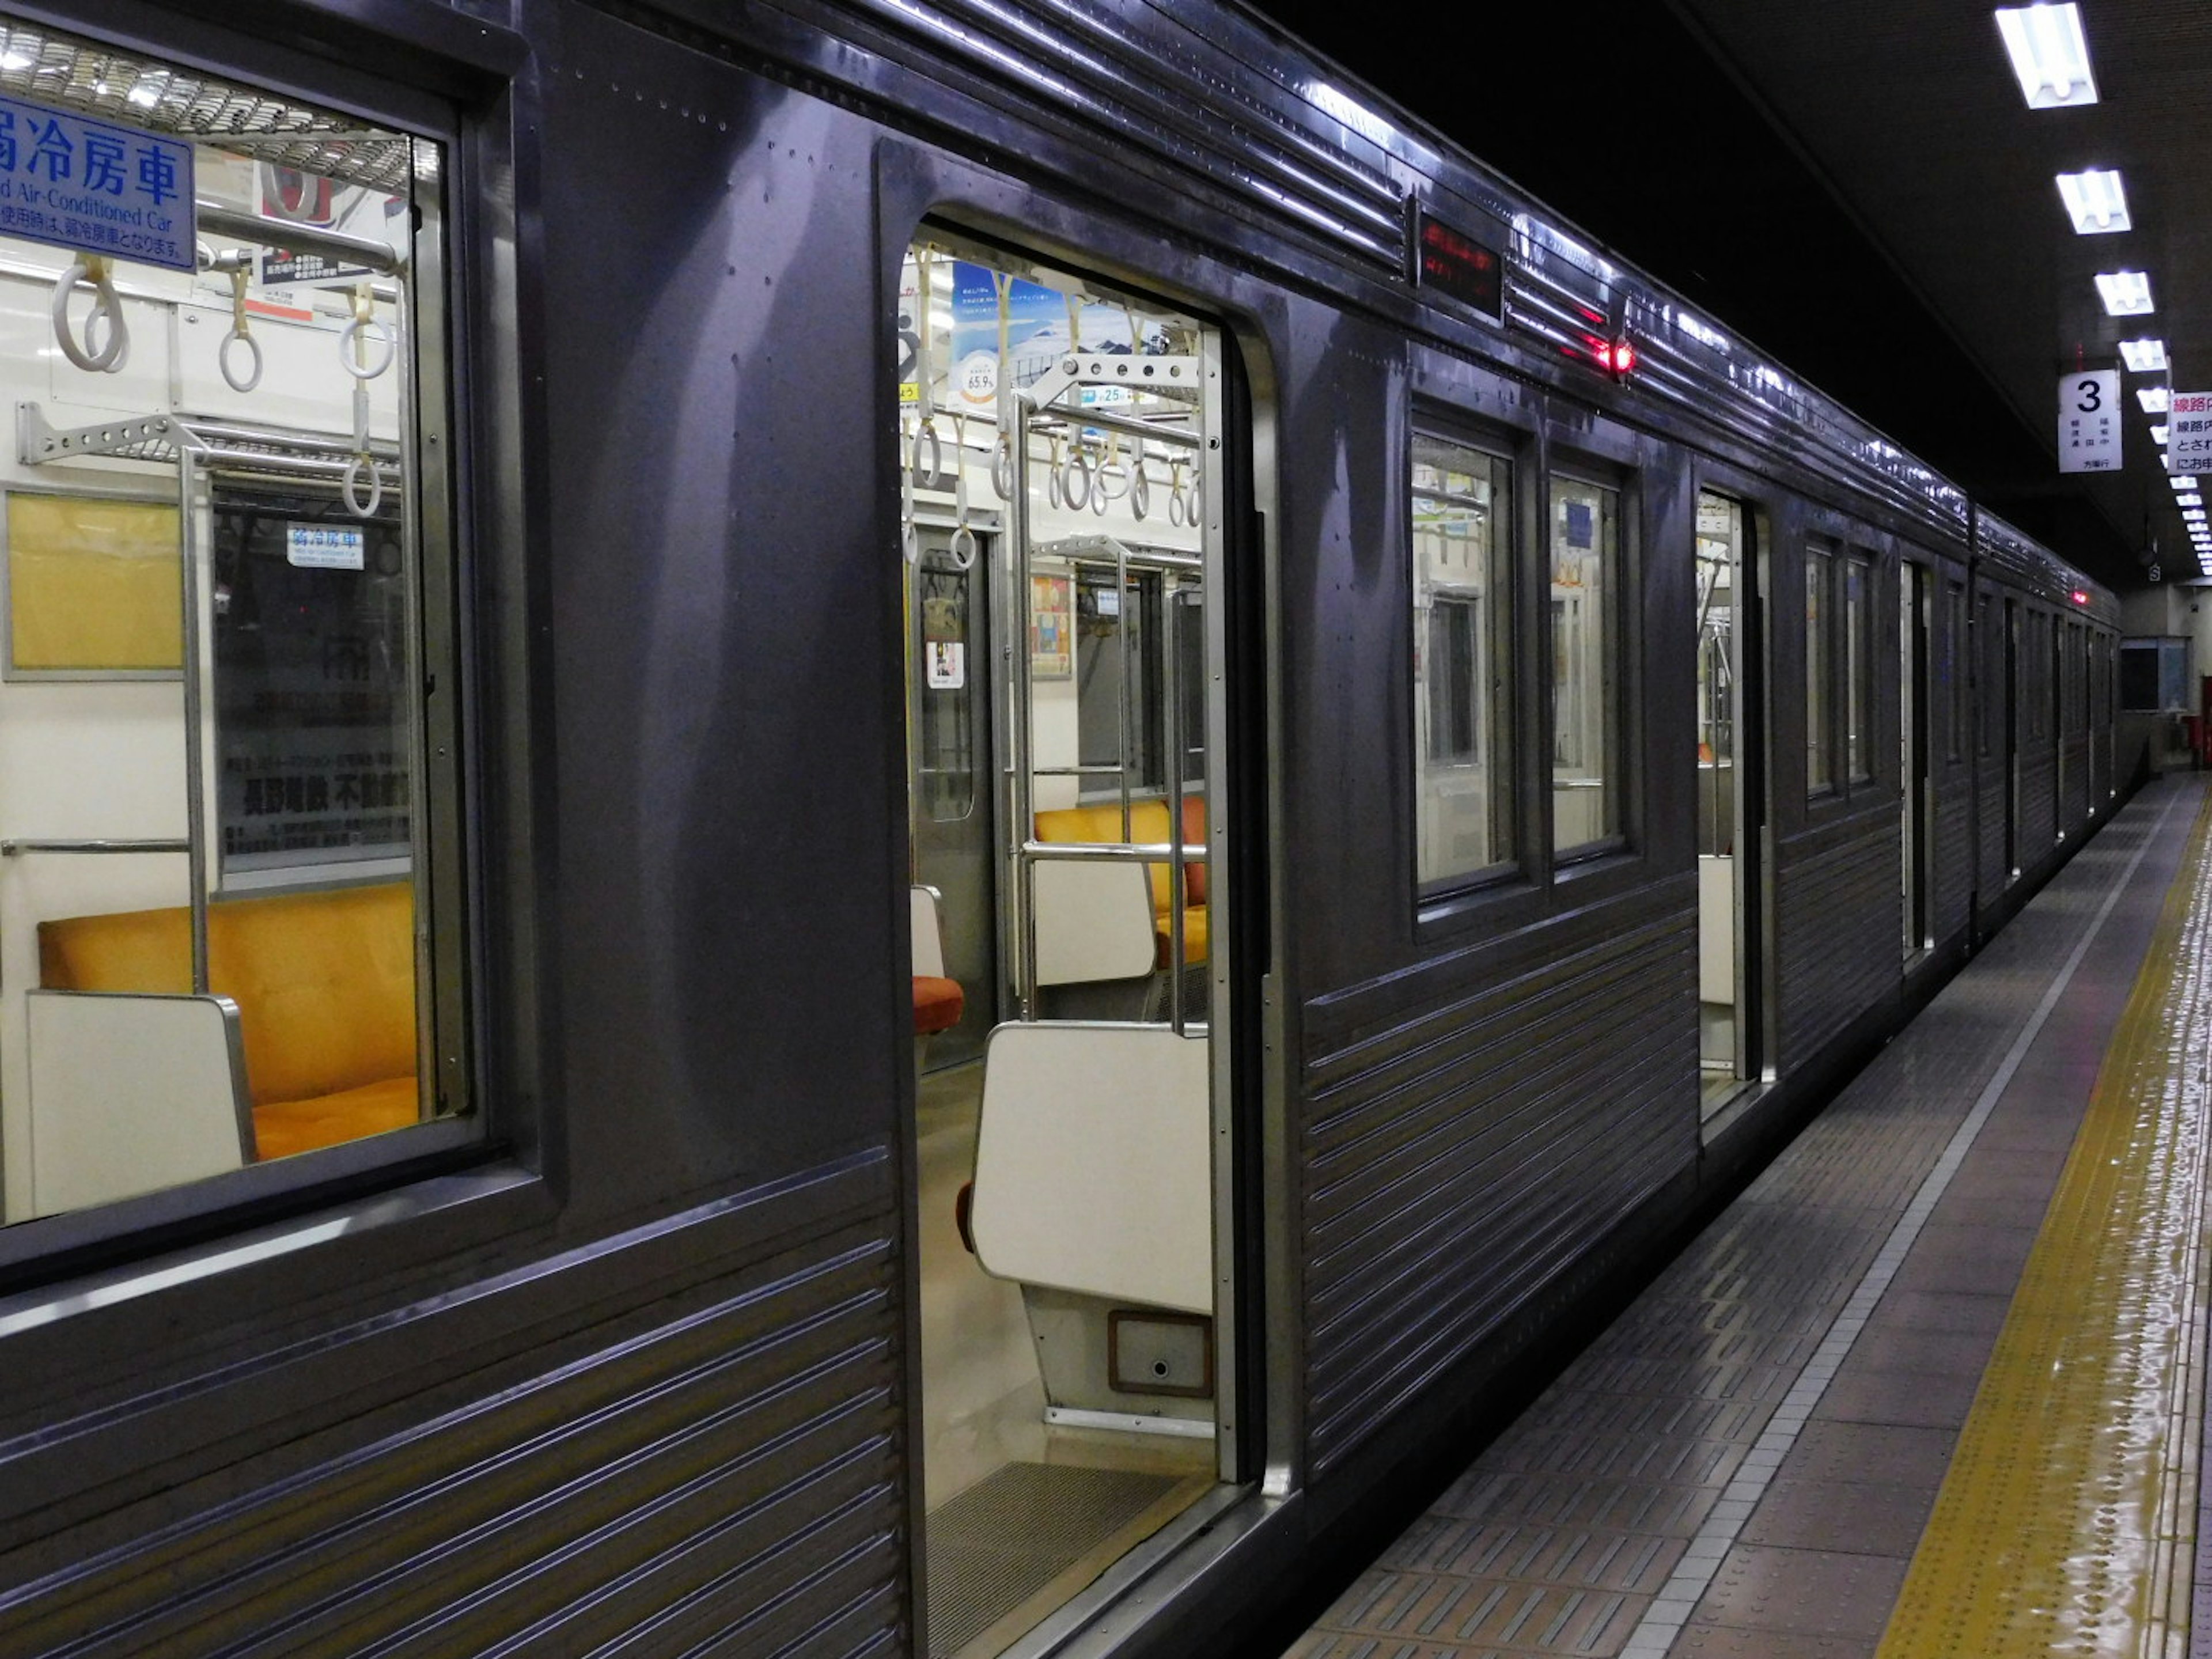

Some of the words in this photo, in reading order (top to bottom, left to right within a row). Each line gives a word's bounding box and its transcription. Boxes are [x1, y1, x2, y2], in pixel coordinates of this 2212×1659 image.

[19, 183, 141, 226] Air-Conditioned
[147, 210, 172, 232] Car
[2077, 380, 2102, 412] 3
